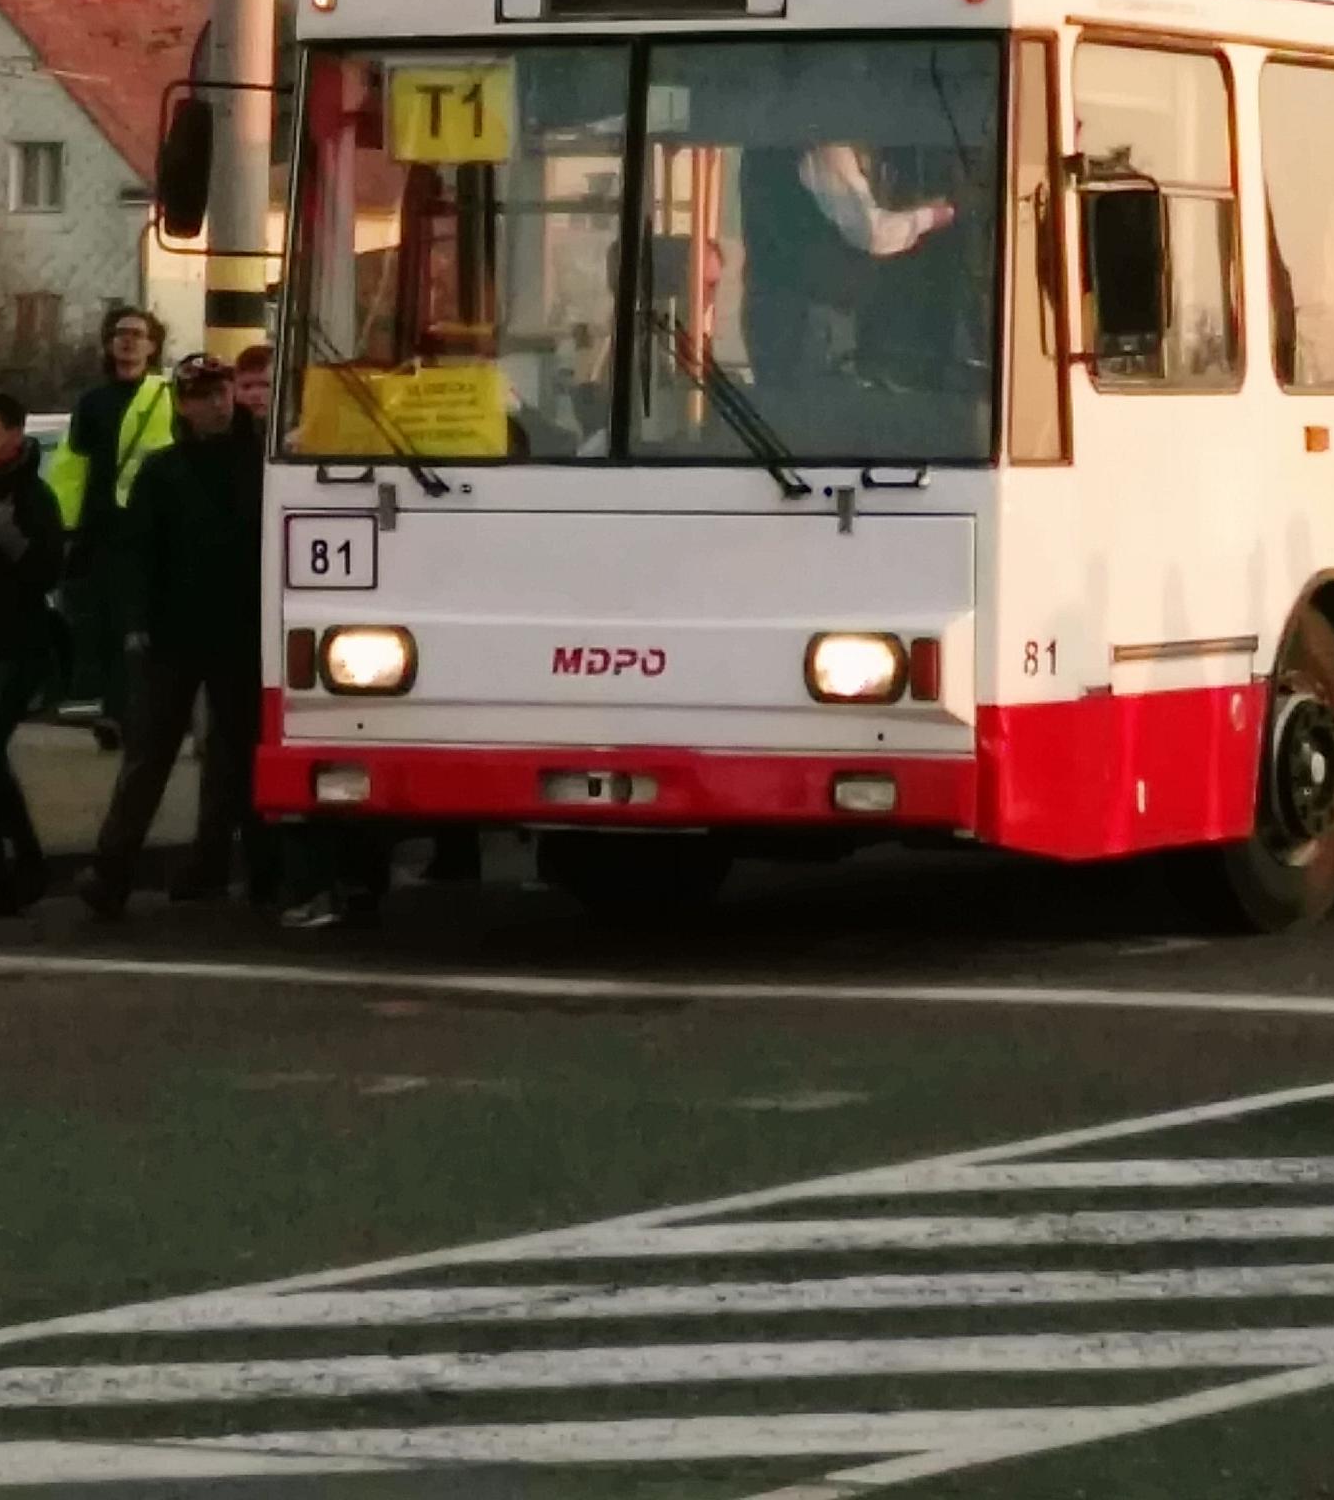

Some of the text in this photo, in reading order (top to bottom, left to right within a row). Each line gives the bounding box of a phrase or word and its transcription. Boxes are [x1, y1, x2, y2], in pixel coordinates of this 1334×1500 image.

[415, 83, 483, 139] T1
[310, 538, 352, 576] 81
[551, 646, 667, 677] MDPO
[1023, 639, 1057, 677] 81
